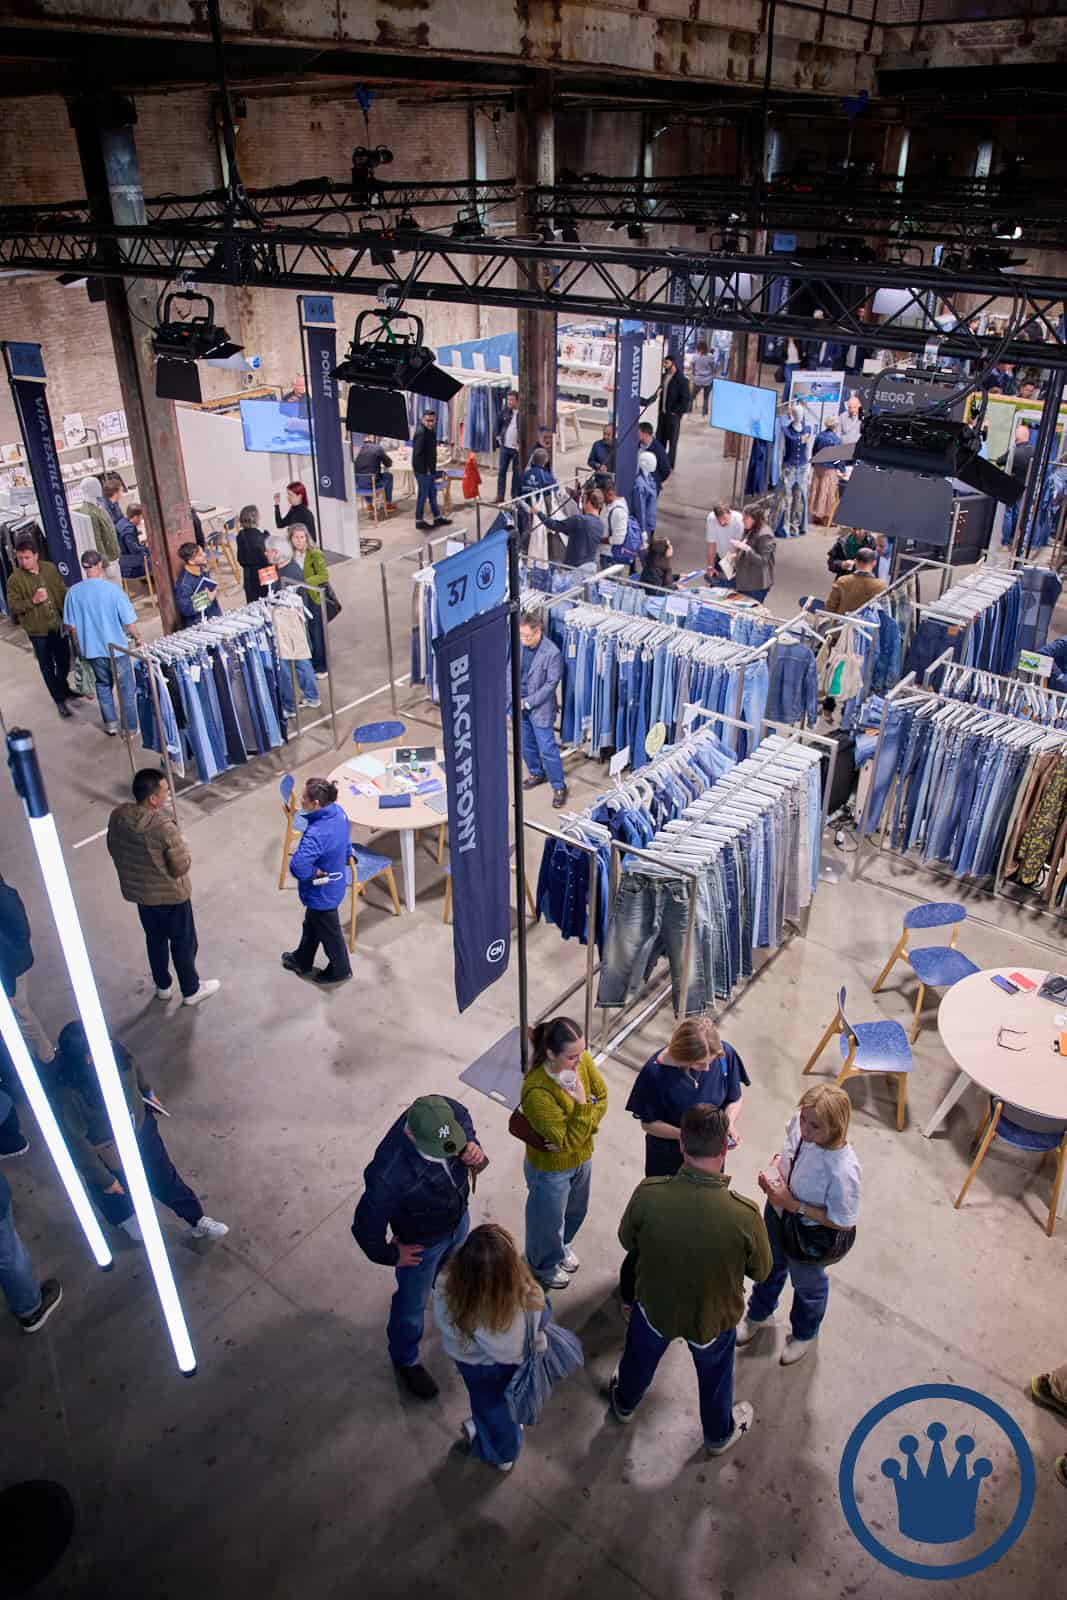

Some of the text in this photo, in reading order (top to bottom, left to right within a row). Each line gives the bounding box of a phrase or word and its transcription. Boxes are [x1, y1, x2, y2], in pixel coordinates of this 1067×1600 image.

[41, 435, 61, 491] TEXTILE
[54, 493, 73, 550] GROUP
[446, 573, 468, 608] 37
[450, 653, 477, 853] BLACK PEONY
